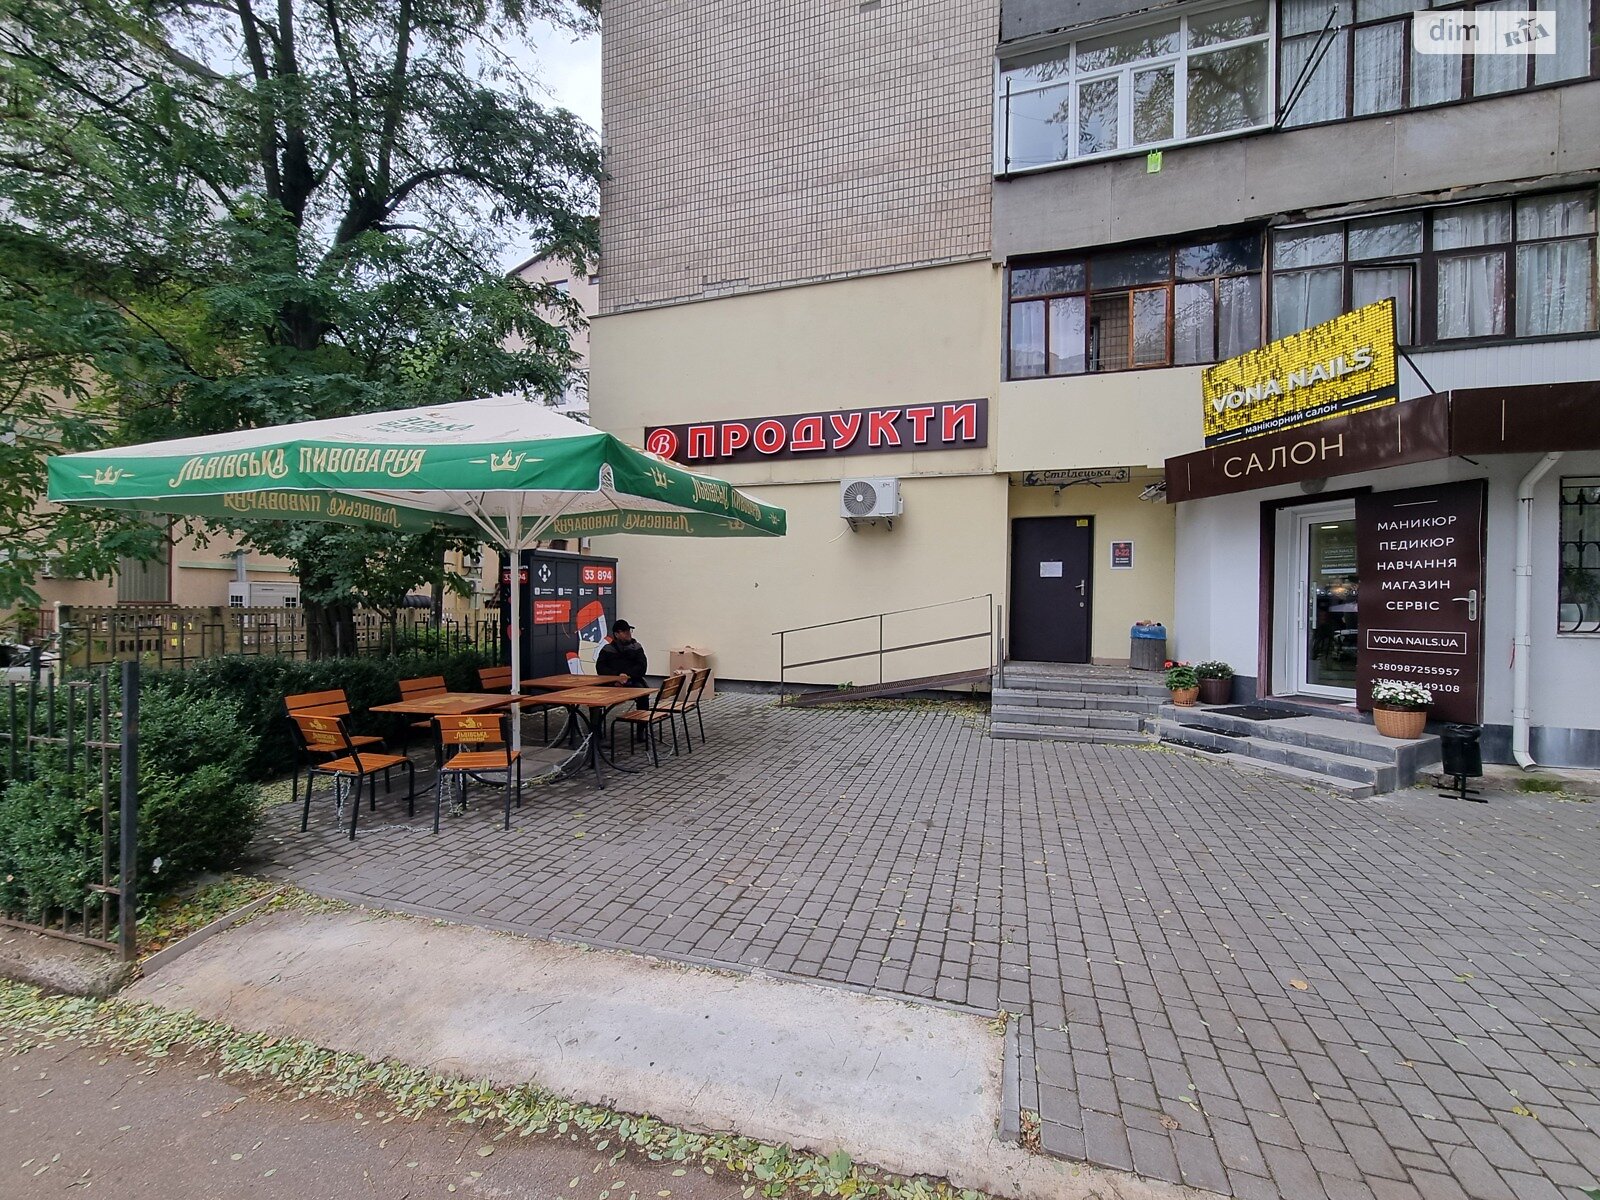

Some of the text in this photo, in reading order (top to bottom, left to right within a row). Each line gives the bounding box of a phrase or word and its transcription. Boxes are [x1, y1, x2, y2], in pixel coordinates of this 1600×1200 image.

[1213, 347, 1373, 413] VONA NAILS
[1245, 403, 1338, 436] манікюрний салон
[687, 402, 977, 459] ПРОДУКТИ
[1224, 433, 1344, 478] САЛОН
[168, 447, 427, 488] ЛЬВІВСЬКА ПИВОВАРНЯ
[1377, 515, 1457, 531] МАНИКЮР
[1379, 537, 1455, 551] ПЕДИКЮР
[1377, 558, 1457, 571] НАВЧАННЯ
[584, 569, 612, 581] 33 894
[1381, 580, 1451, 591] МАГАЗИН
[1385, 601, 1440, 611] СЕРВІС
[1373, 636, 1459, 647] VONA NAILS.UA
[1371, 662, 1460, 676] +380987255957
